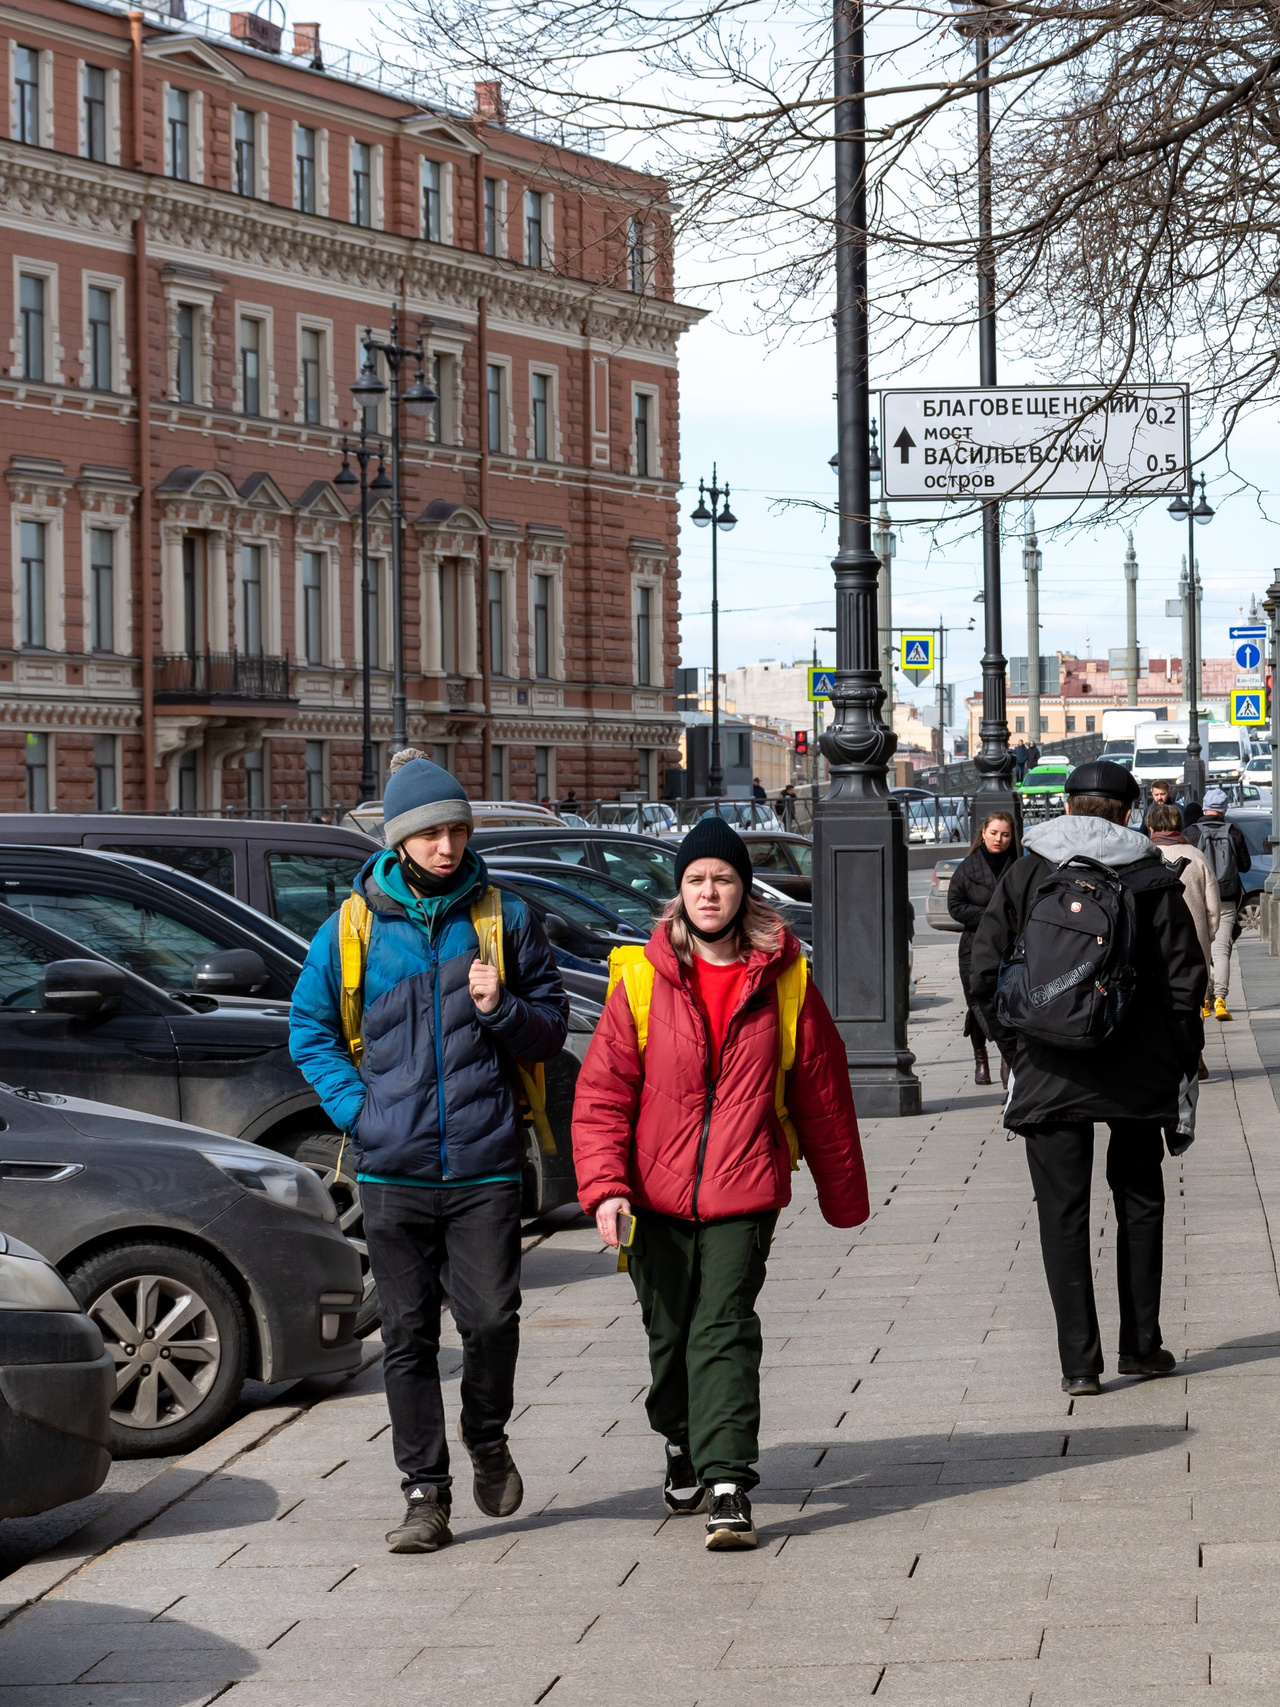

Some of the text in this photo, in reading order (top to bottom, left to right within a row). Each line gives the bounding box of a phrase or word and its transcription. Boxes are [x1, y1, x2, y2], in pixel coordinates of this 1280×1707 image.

[923, 390, 1139, 418] БЛАГОВЕЩЕНСКИЙ
[1146, 406, 1176, 426] 0.2
[924, 438, 1104, 465] ВАСИЛЬЕВСКИЙ
[1146, 453, 1177, 473] 0.5
